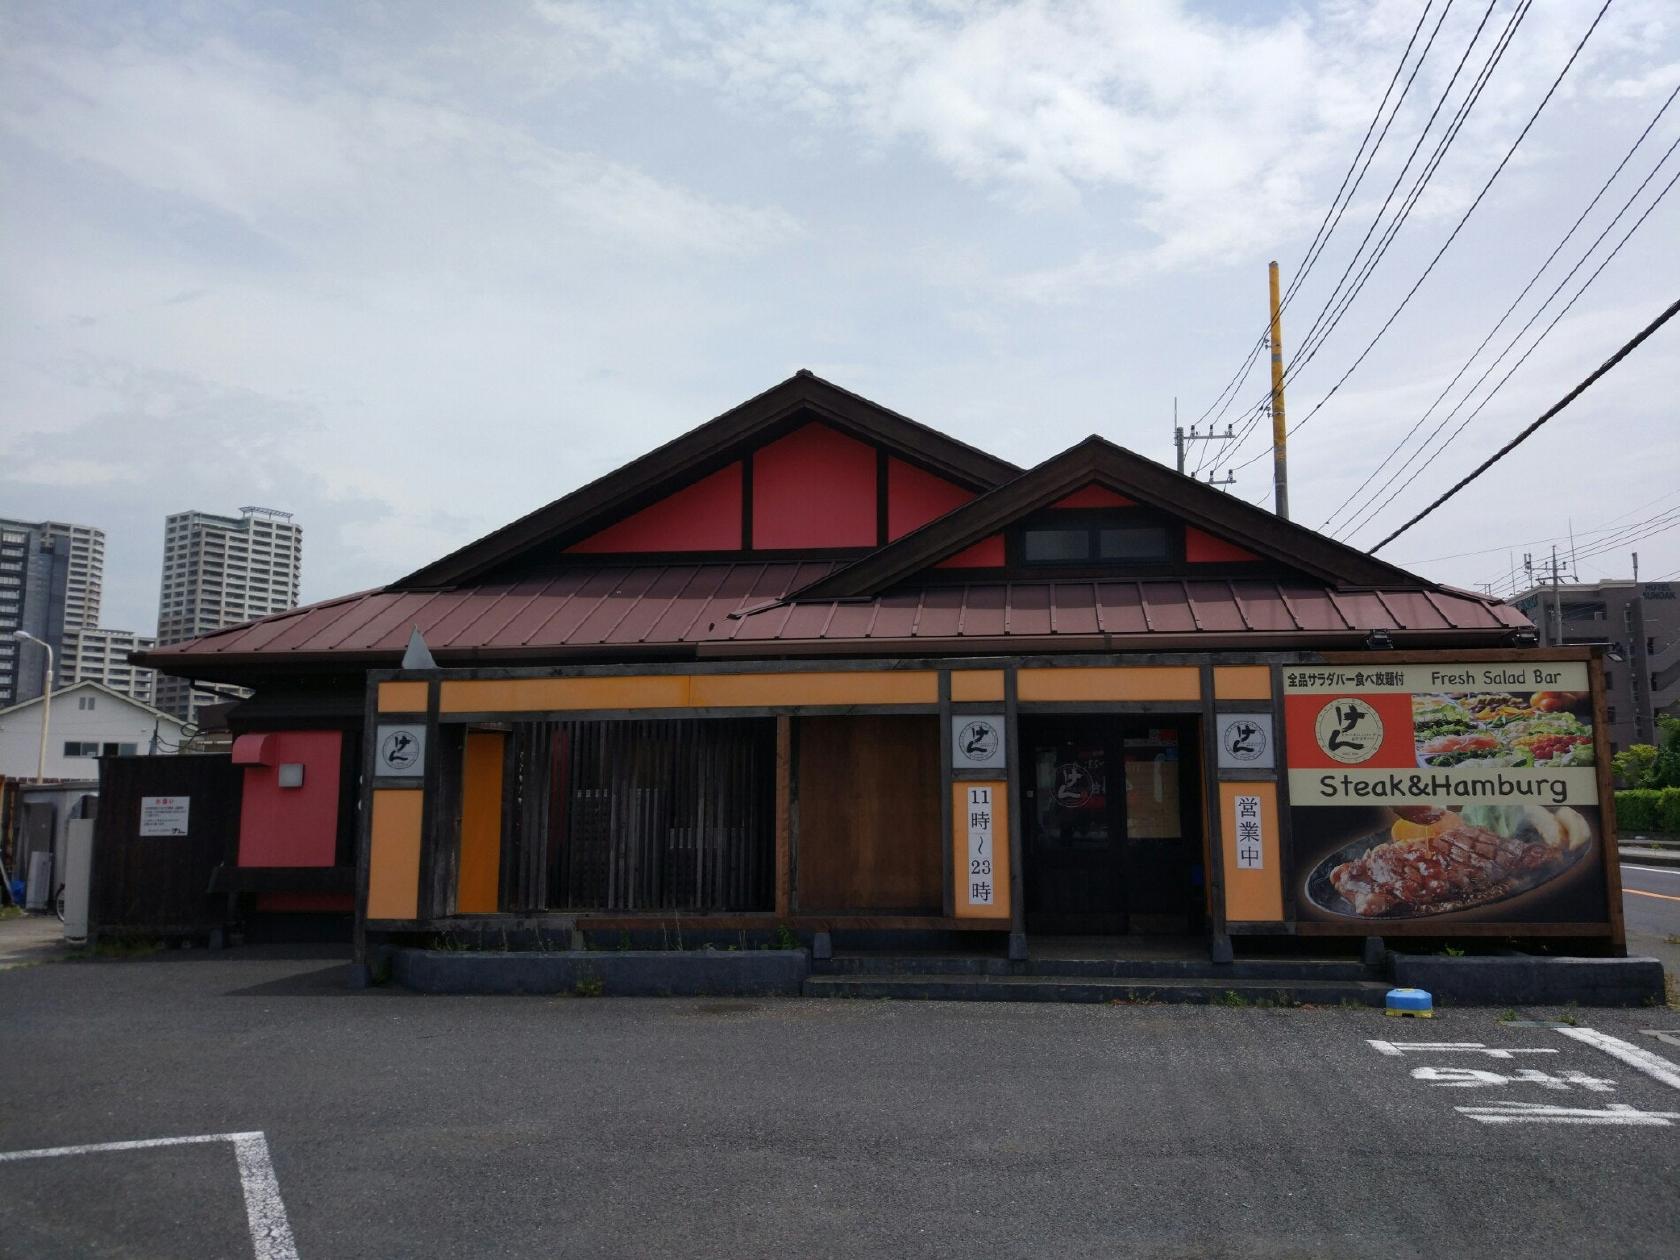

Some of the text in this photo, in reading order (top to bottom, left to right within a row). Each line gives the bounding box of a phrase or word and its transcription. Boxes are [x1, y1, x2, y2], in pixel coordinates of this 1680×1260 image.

[1645, 583, 1671, 591] HOTEL
[1287, 671, 1404, 687] 全品サラダバー食べ放題付
[1430, 669, 1561, 685] Fresh Salad Bar
[1328, 704, 1368, 751] けん
[1320, 774, 1568, 802] Steak&Hamburg
[1238, 797, 1259, 867] 営業中
